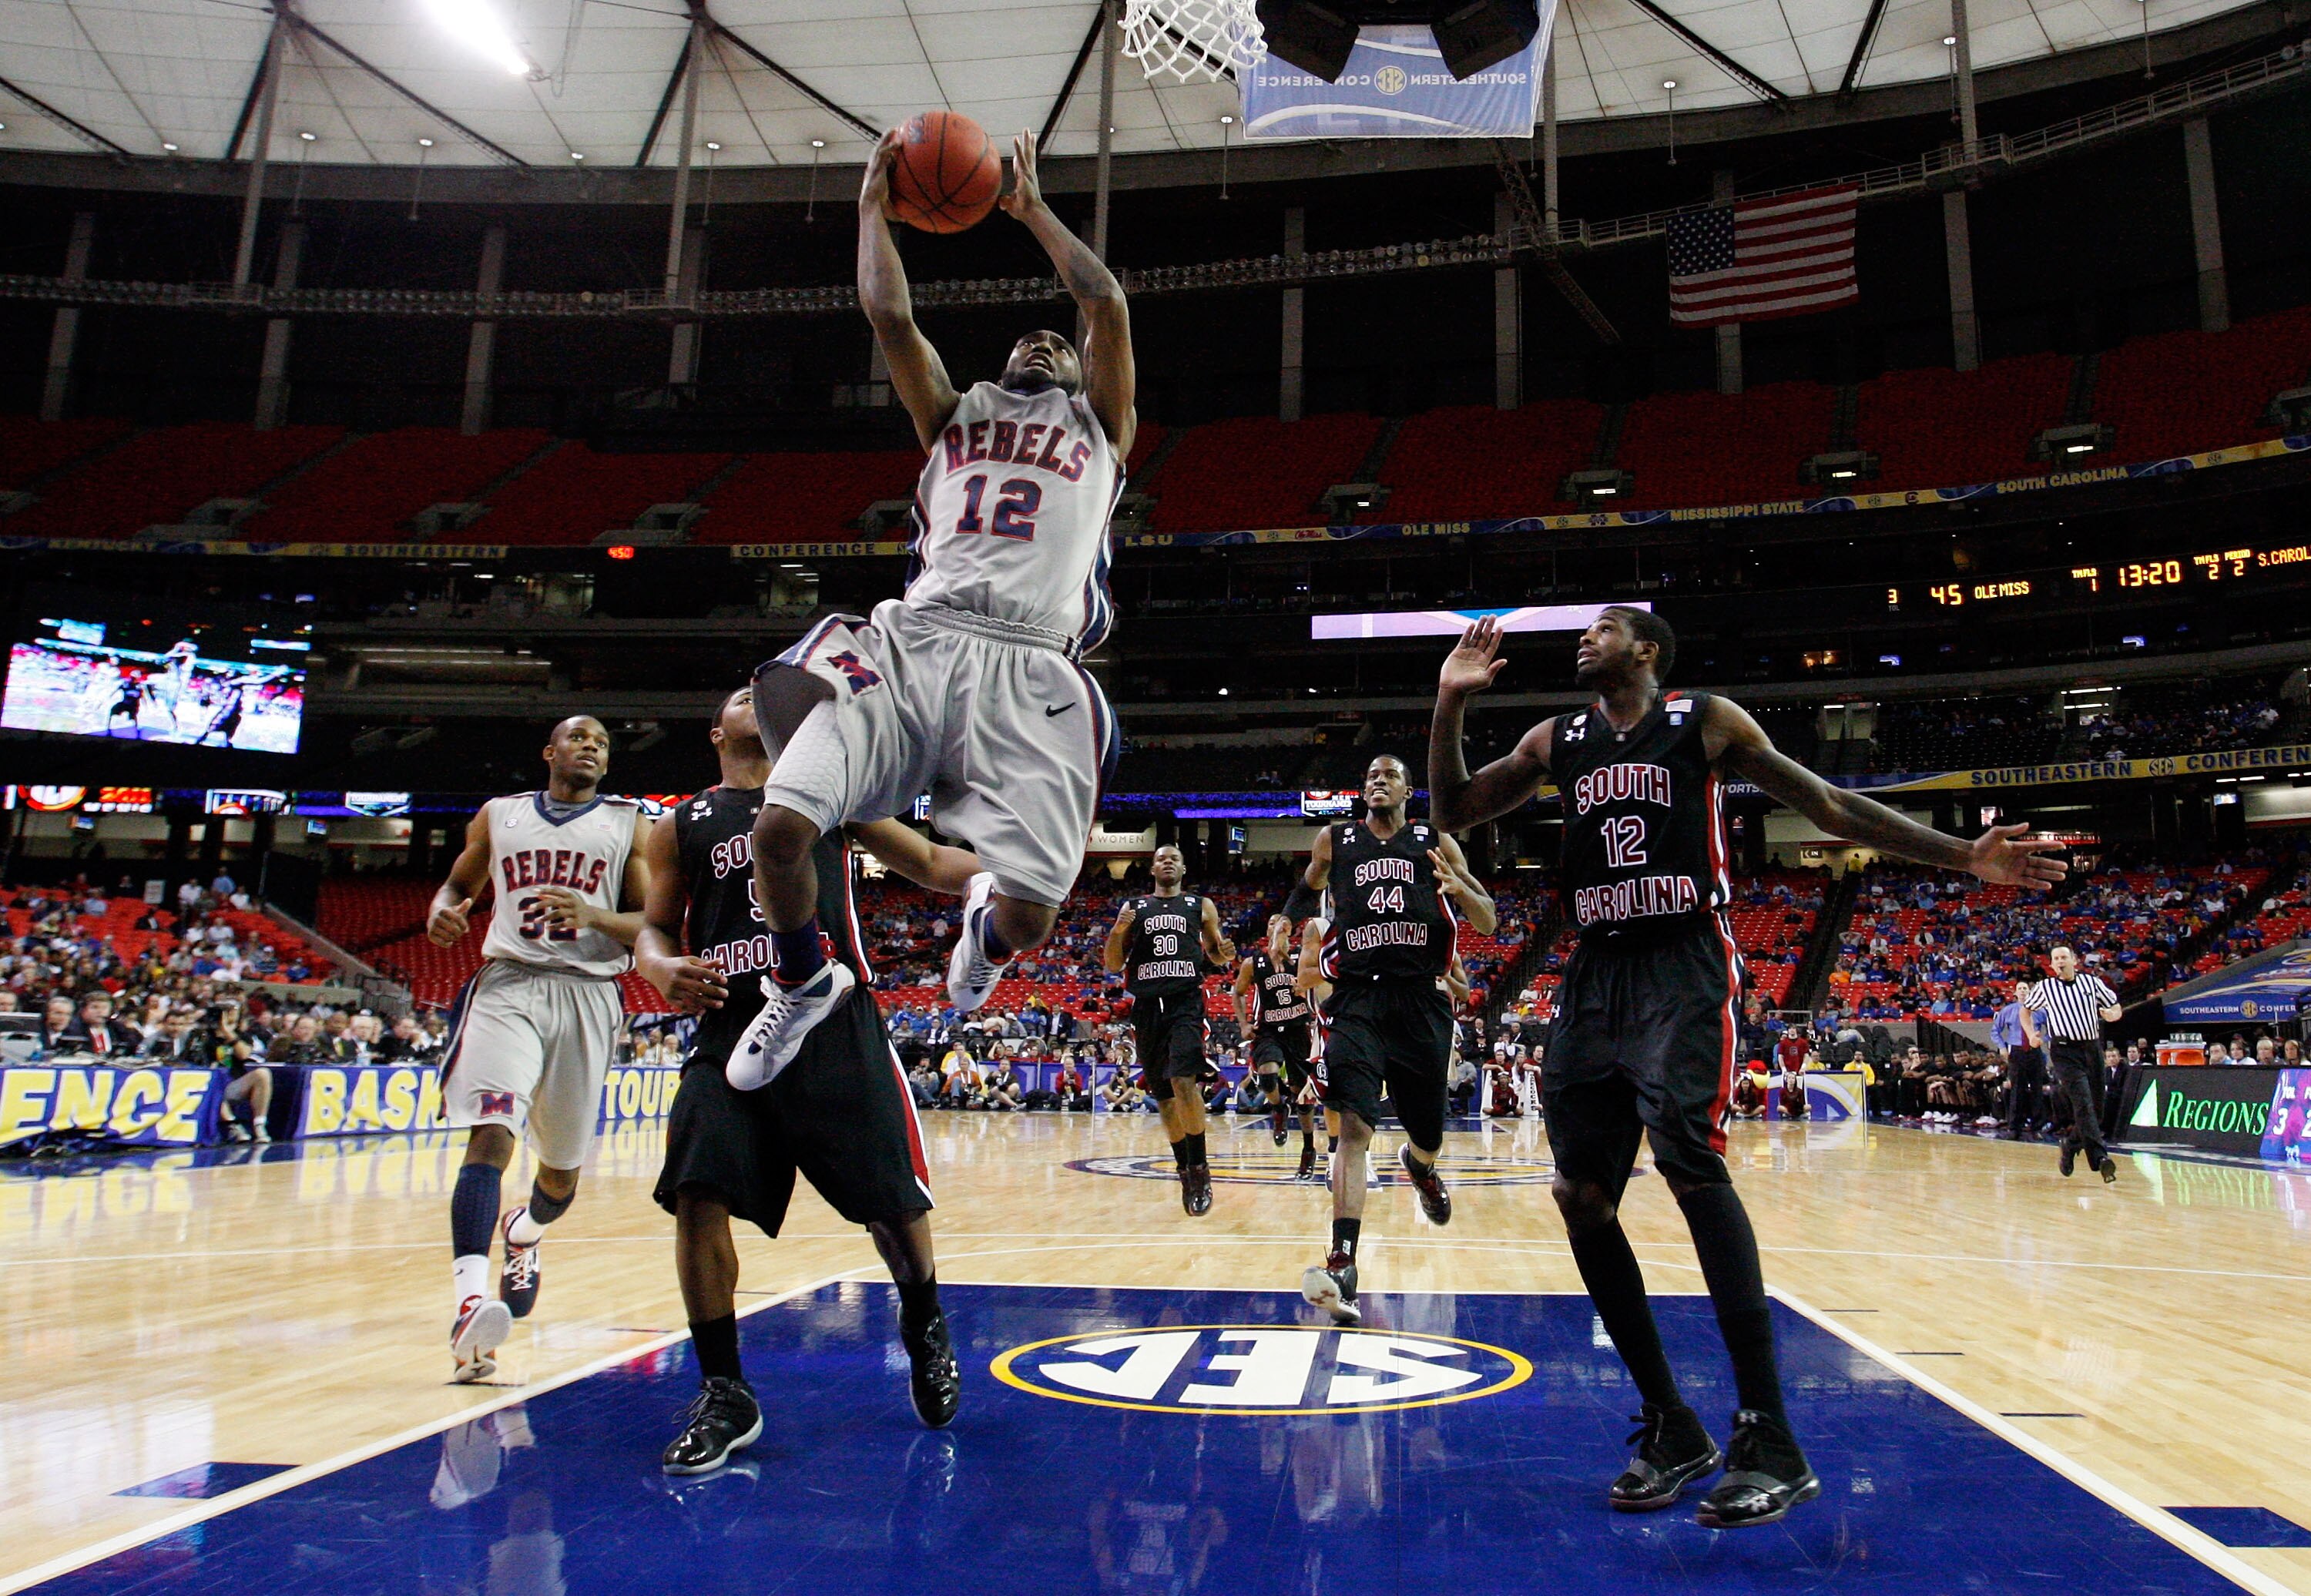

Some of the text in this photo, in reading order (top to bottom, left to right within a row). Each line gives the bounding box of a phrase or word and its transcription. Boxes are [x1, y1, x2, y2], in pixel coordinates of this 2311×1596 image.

[944, 420, 1092, 482] REBELS
[1996, 467, 2129, 495] SOUTH CAROLINA
[956, 474, 1041, 541] 12
[1670, 501, 1805, 521] MISSISSIPPI STATE
[1402, 521, 1471, 535] OLE MISS
[344, 545, 500, 557] SOUTHEASTERN
[740, 542, 876, 557] CONFERENCE
[1125, 534, 1174, 548] LSU
[2224, 548, 2251, 561] PERIOD
[2119, 561, 2181, 587] 13:20
[2209, 564, 2219, 580] 2
[2234, 559, 2244, 576] 2
[1887, 588, 1898, 605] 3
[1930, 584, 1963, 605] 45
[1974, 581, 2030, 599] OLE MISS
[1971, 761, 2132, 786] SOUTHEASTERN
[2185, 746, 2311, 770] CONFEREN
[1575, 763, 1671, 815] SOUTH
[1726, 783, 1763, 793] ORTS
[1097, 834, 1145, 844] WOMEN
[1601, 815, 1647, 868] 12
[501, 849, 608, 895] REBELS
[1355, 857, 1414, 887] SOUTH
[1367, 886, 1404, 914] 44
[1575, 875, 1699, 926] CAROLINA
[1144, 914, 1186, 934] SOUTH
[1153, 934, 1178, 956] 30
[1346, 921, 1427, 952] CAROLINA
[1137, 960, 1196, 981] CAROLINA
[1276, 988, 1292, 1005] 15
[1264, 1002, 1308, 1022] CAROLINA
[2179, 1005, 2239, 1014] SOUTHEASTERN
[0, 1068, 212, 1146] ENCE
[2162, 1091, 2269, 1136] REGIONS
[2272, 1108, 2289, 1135] 3
